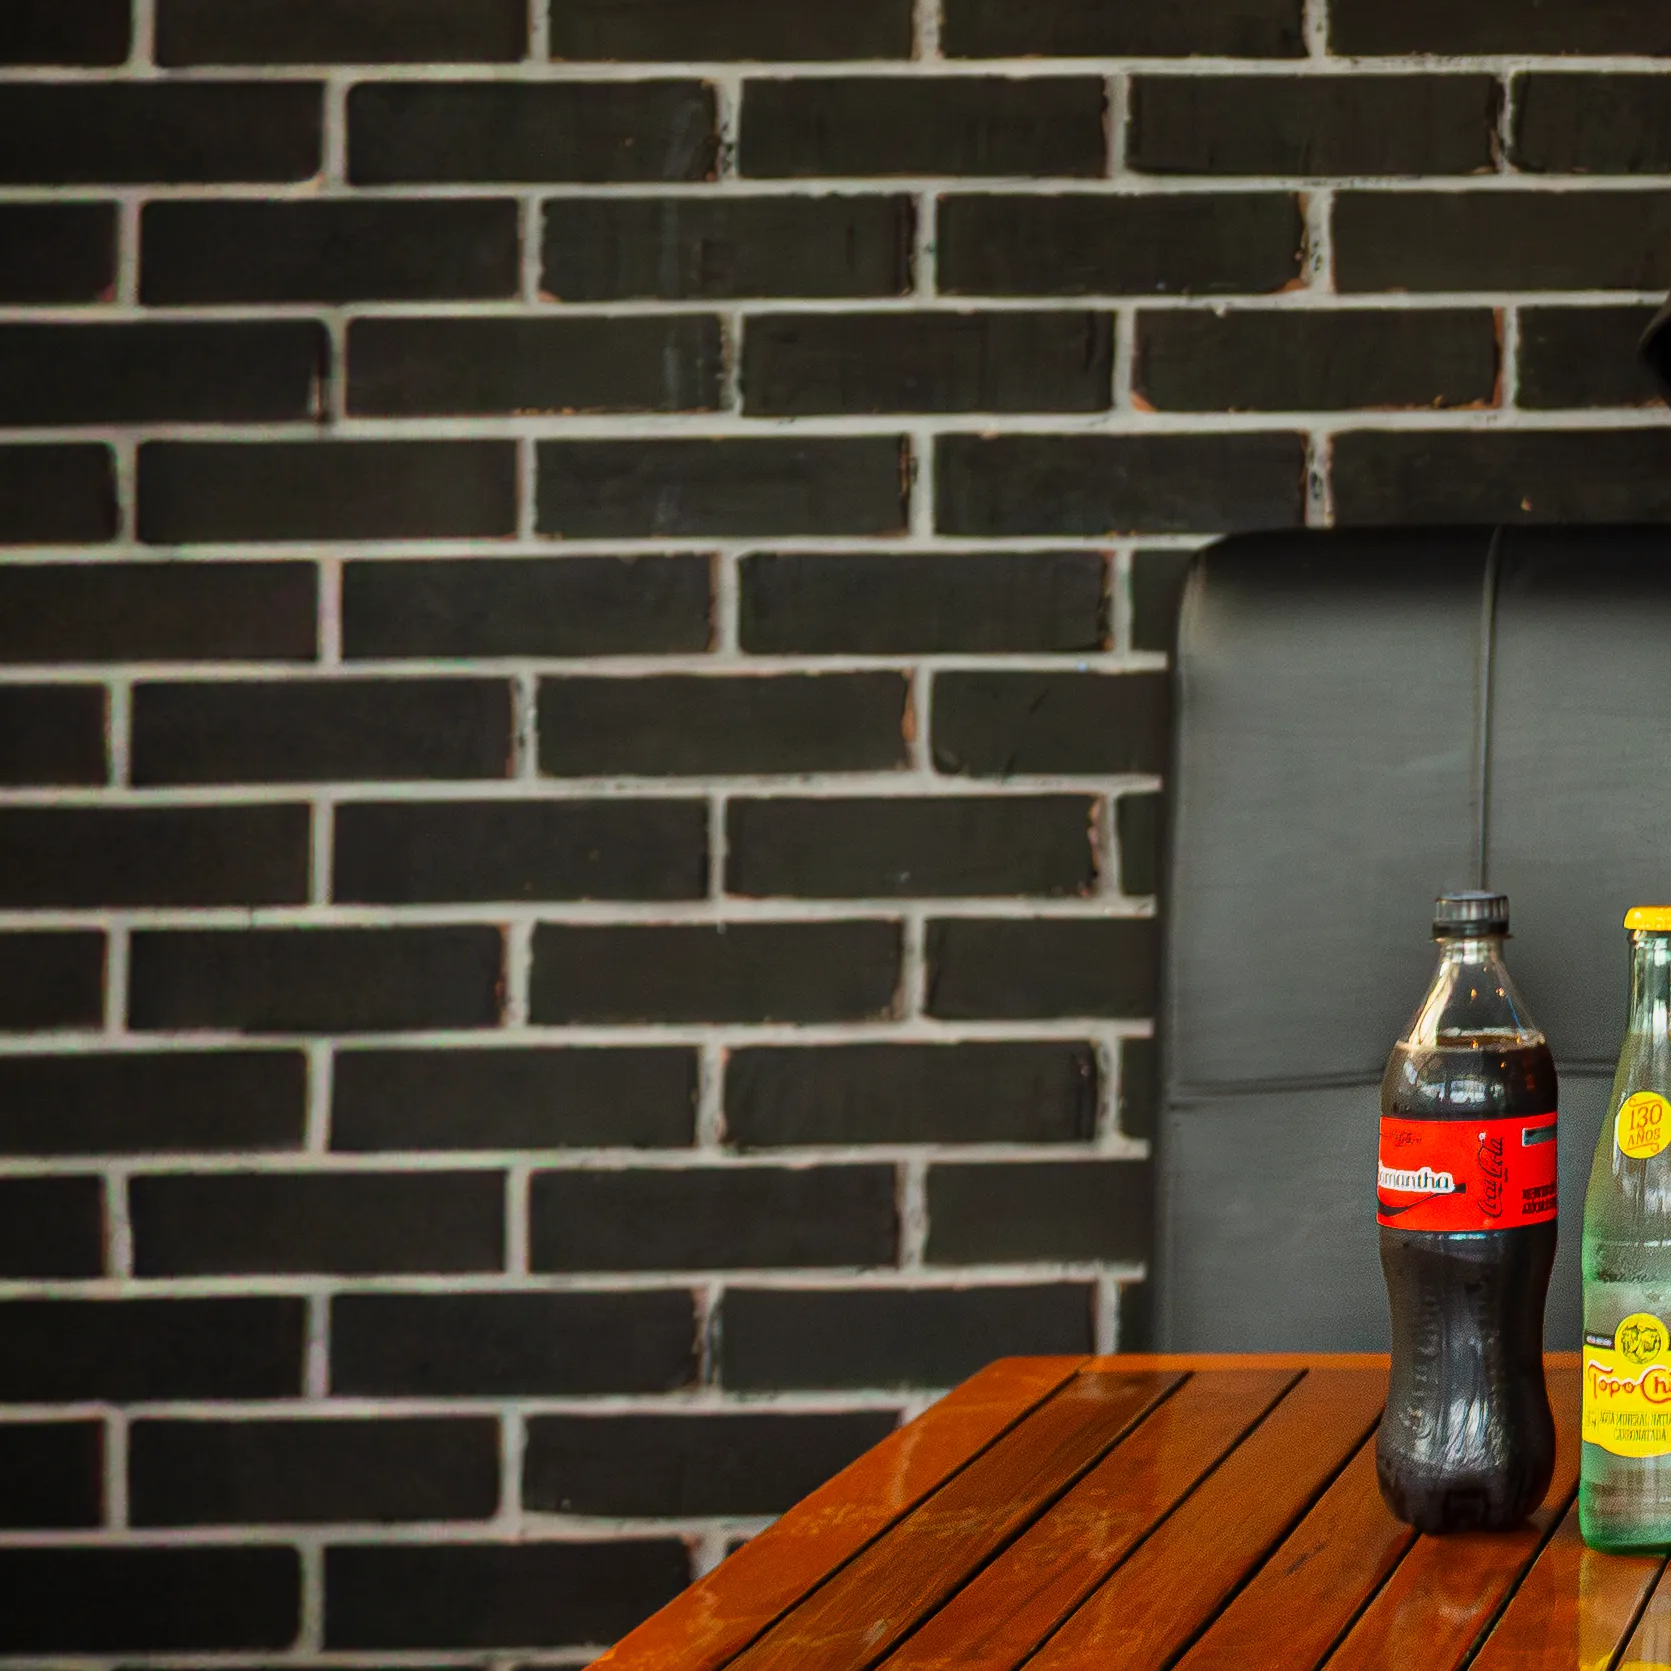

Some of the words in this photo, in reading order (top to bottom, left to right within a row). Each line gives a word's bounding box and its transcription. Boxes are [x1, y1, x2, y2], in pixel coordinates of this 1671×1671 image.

[1629, 1103, 1663, 1131] 130
[1627, 1126, 1661, 1146] AÑOS
[1587, 1359, 1637, 1400] Topo
